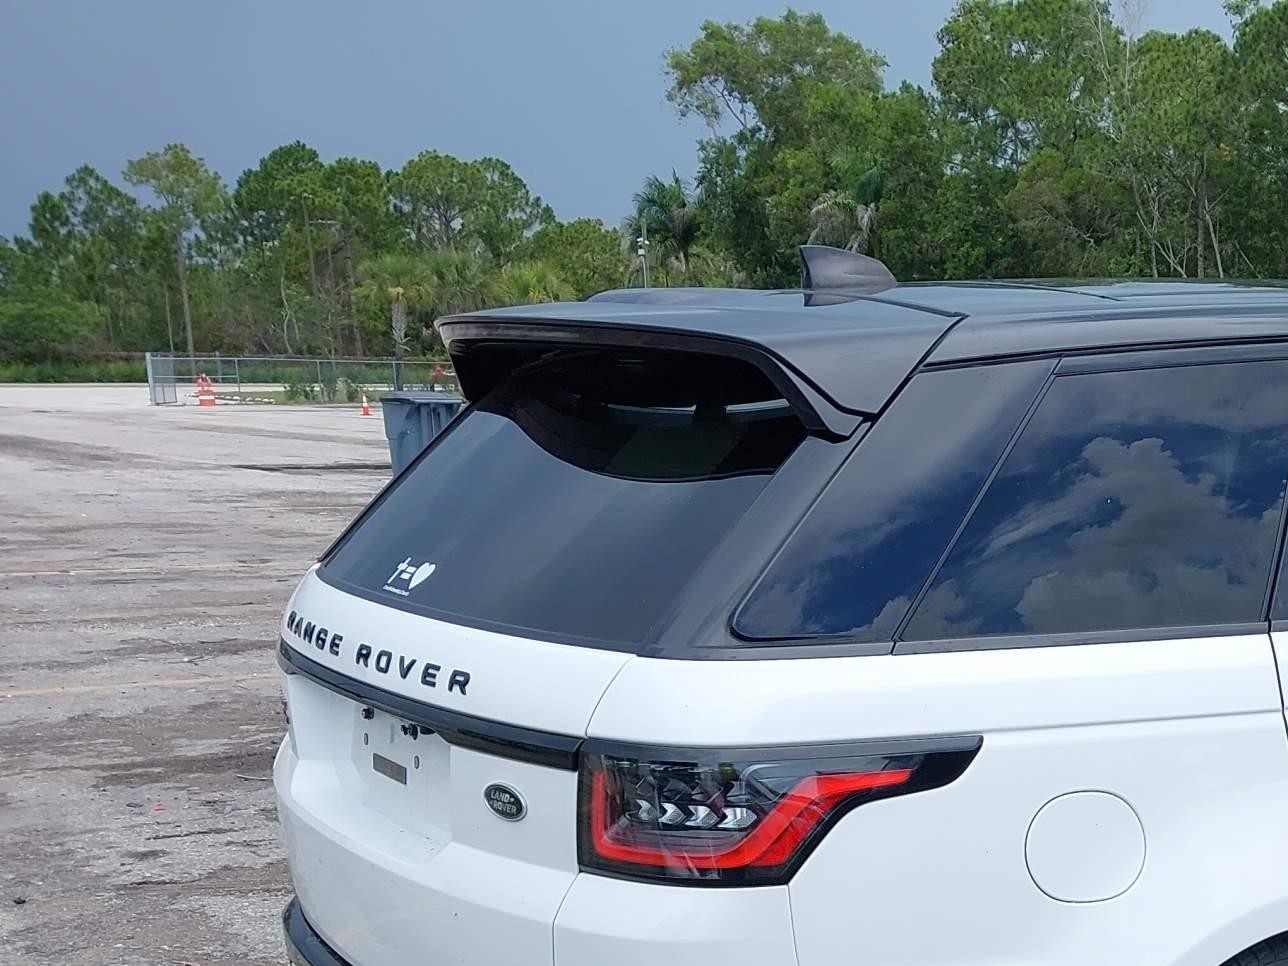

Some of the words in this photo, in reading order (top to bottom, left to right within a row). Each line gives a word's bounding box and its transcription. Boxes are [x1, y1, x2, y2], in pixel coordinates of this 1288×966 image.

[287, 610, 344, 657] RANGE
[355, 643, 471, 696] ROVER
[490, 789, 510, 803] LAND
[493, 799, 517, 815] ROVER
